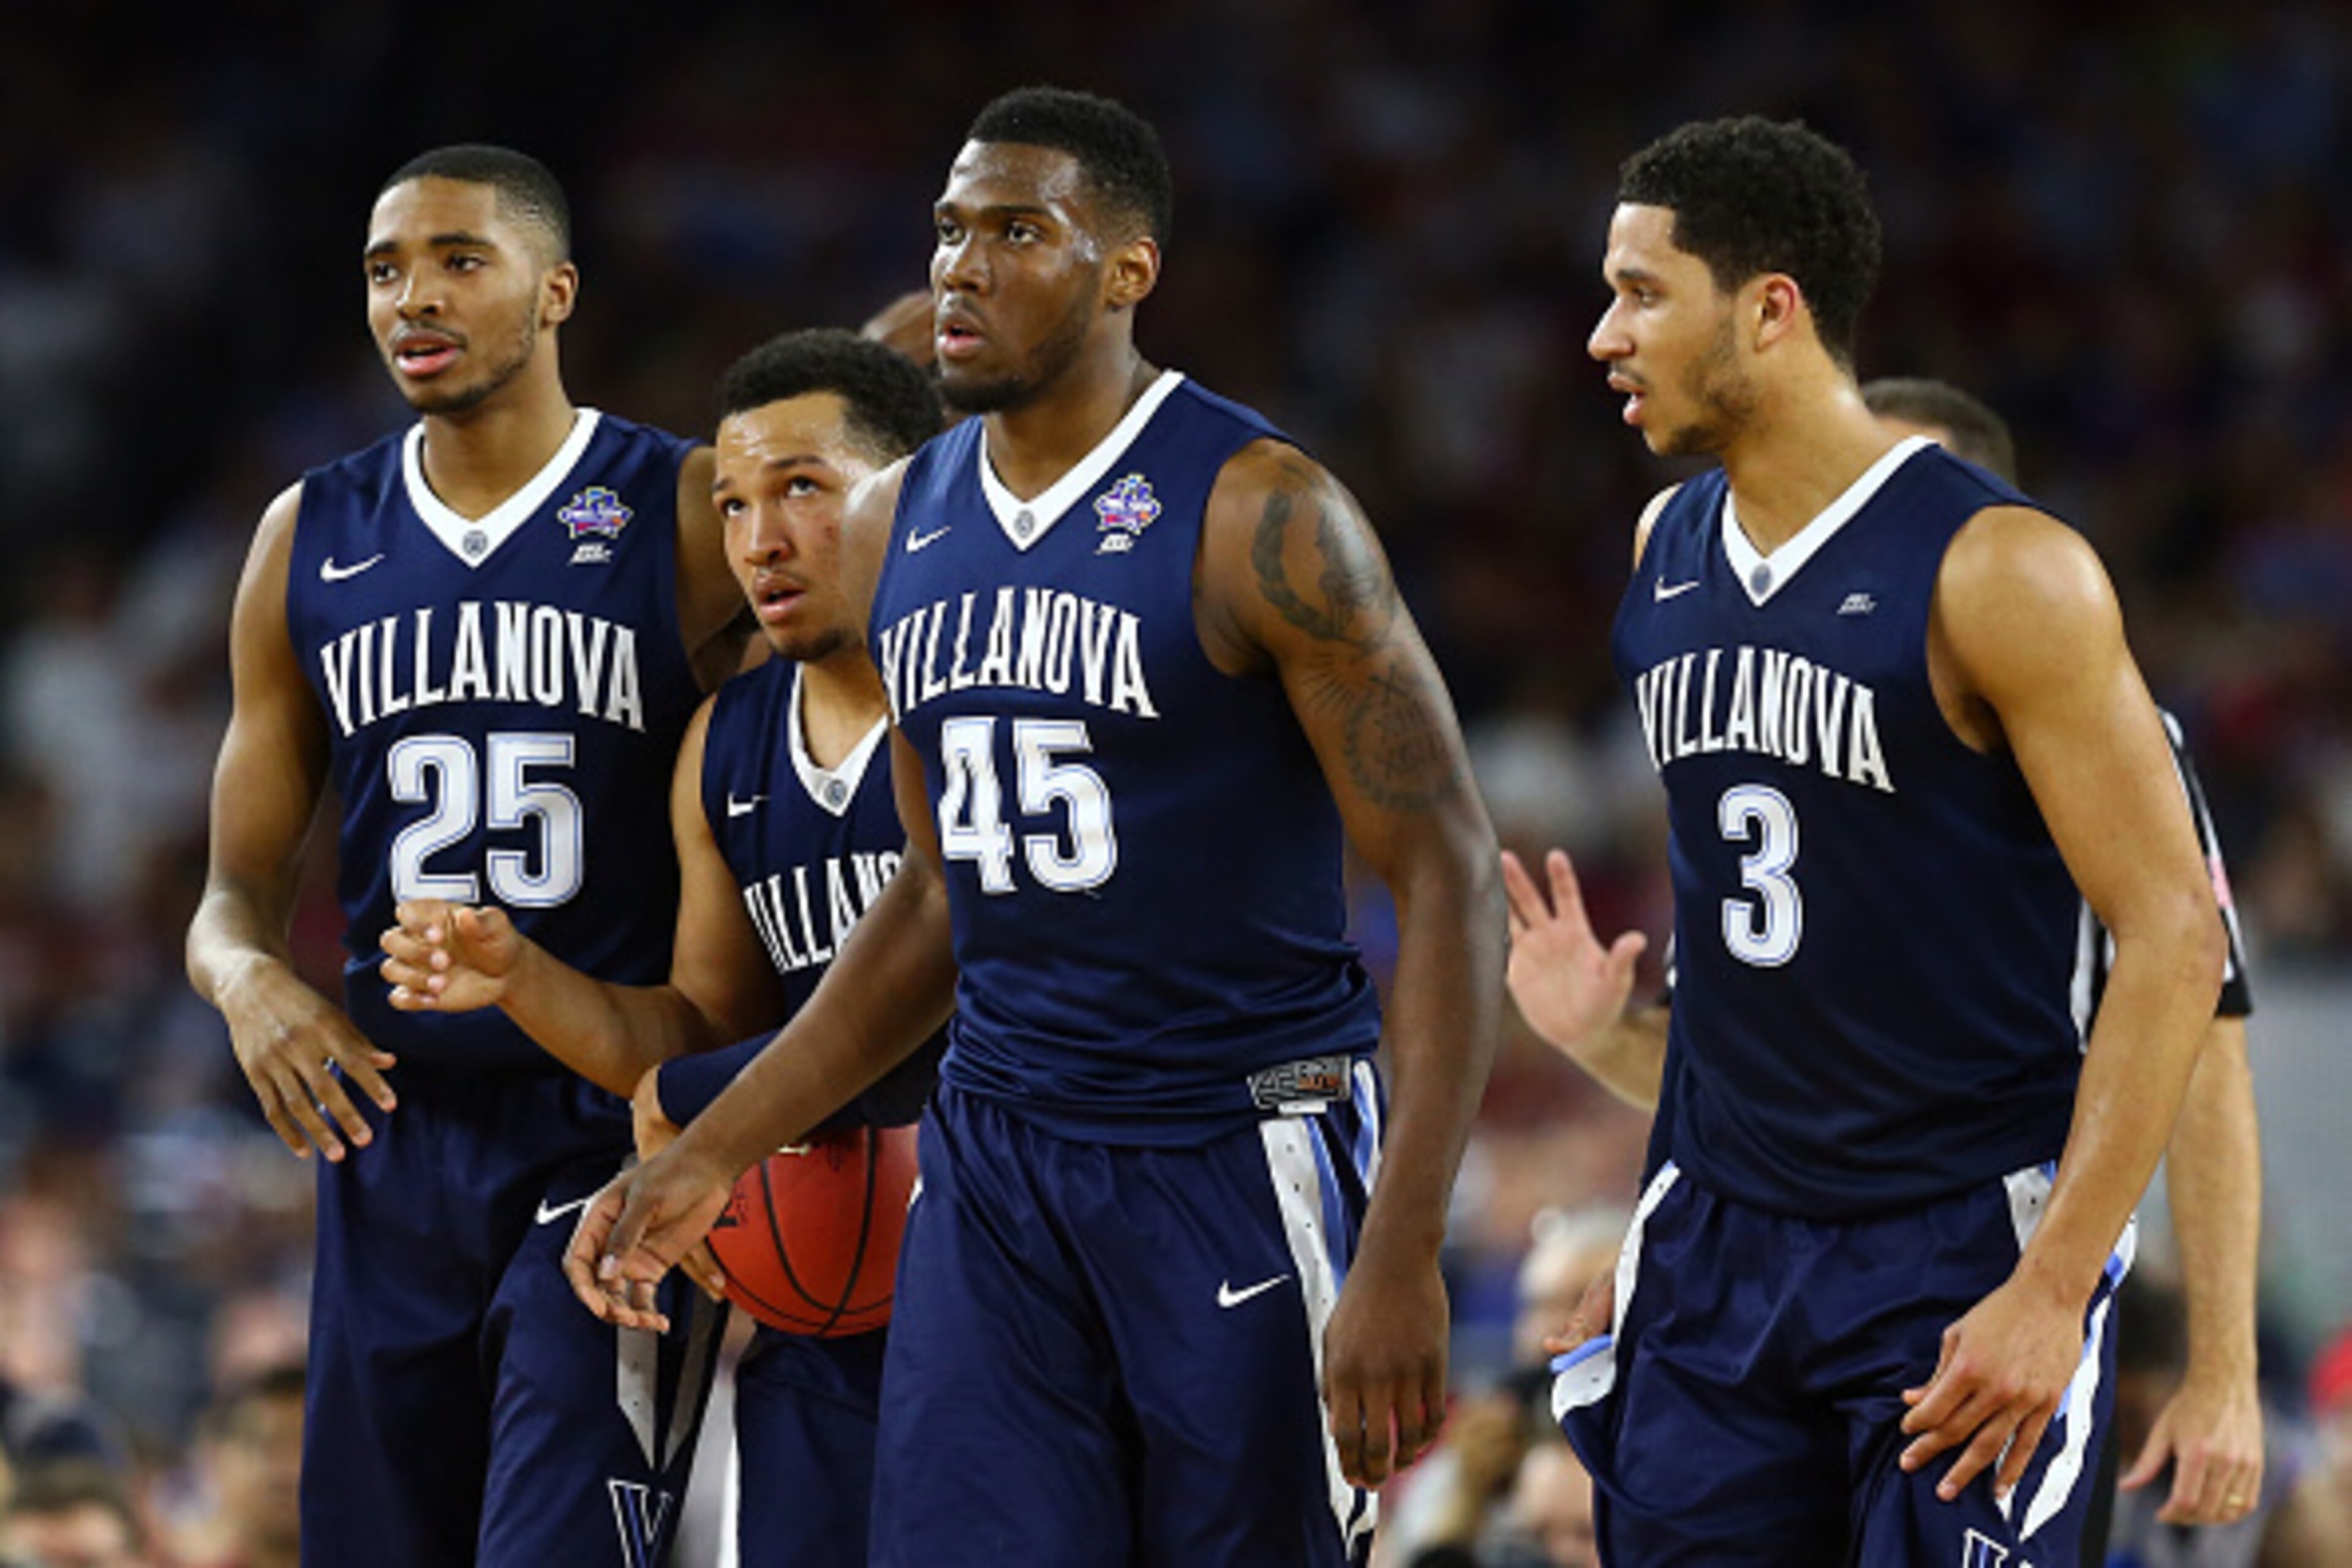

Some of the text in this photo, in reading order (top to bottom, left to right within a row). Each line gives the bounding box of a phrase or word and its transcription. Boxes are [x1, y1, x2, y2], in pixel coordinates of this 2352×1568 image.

[320, 601, 645, 737] VILLANOVA
[880, 586, 1159, 726] VILLANOVA
[1636, 645, 1896, 793] VILLANOVA
[386, 732, 583, 908] 25
[938, 716, 1118, 893] 45
[1717, 783, 1803, 967] 3
